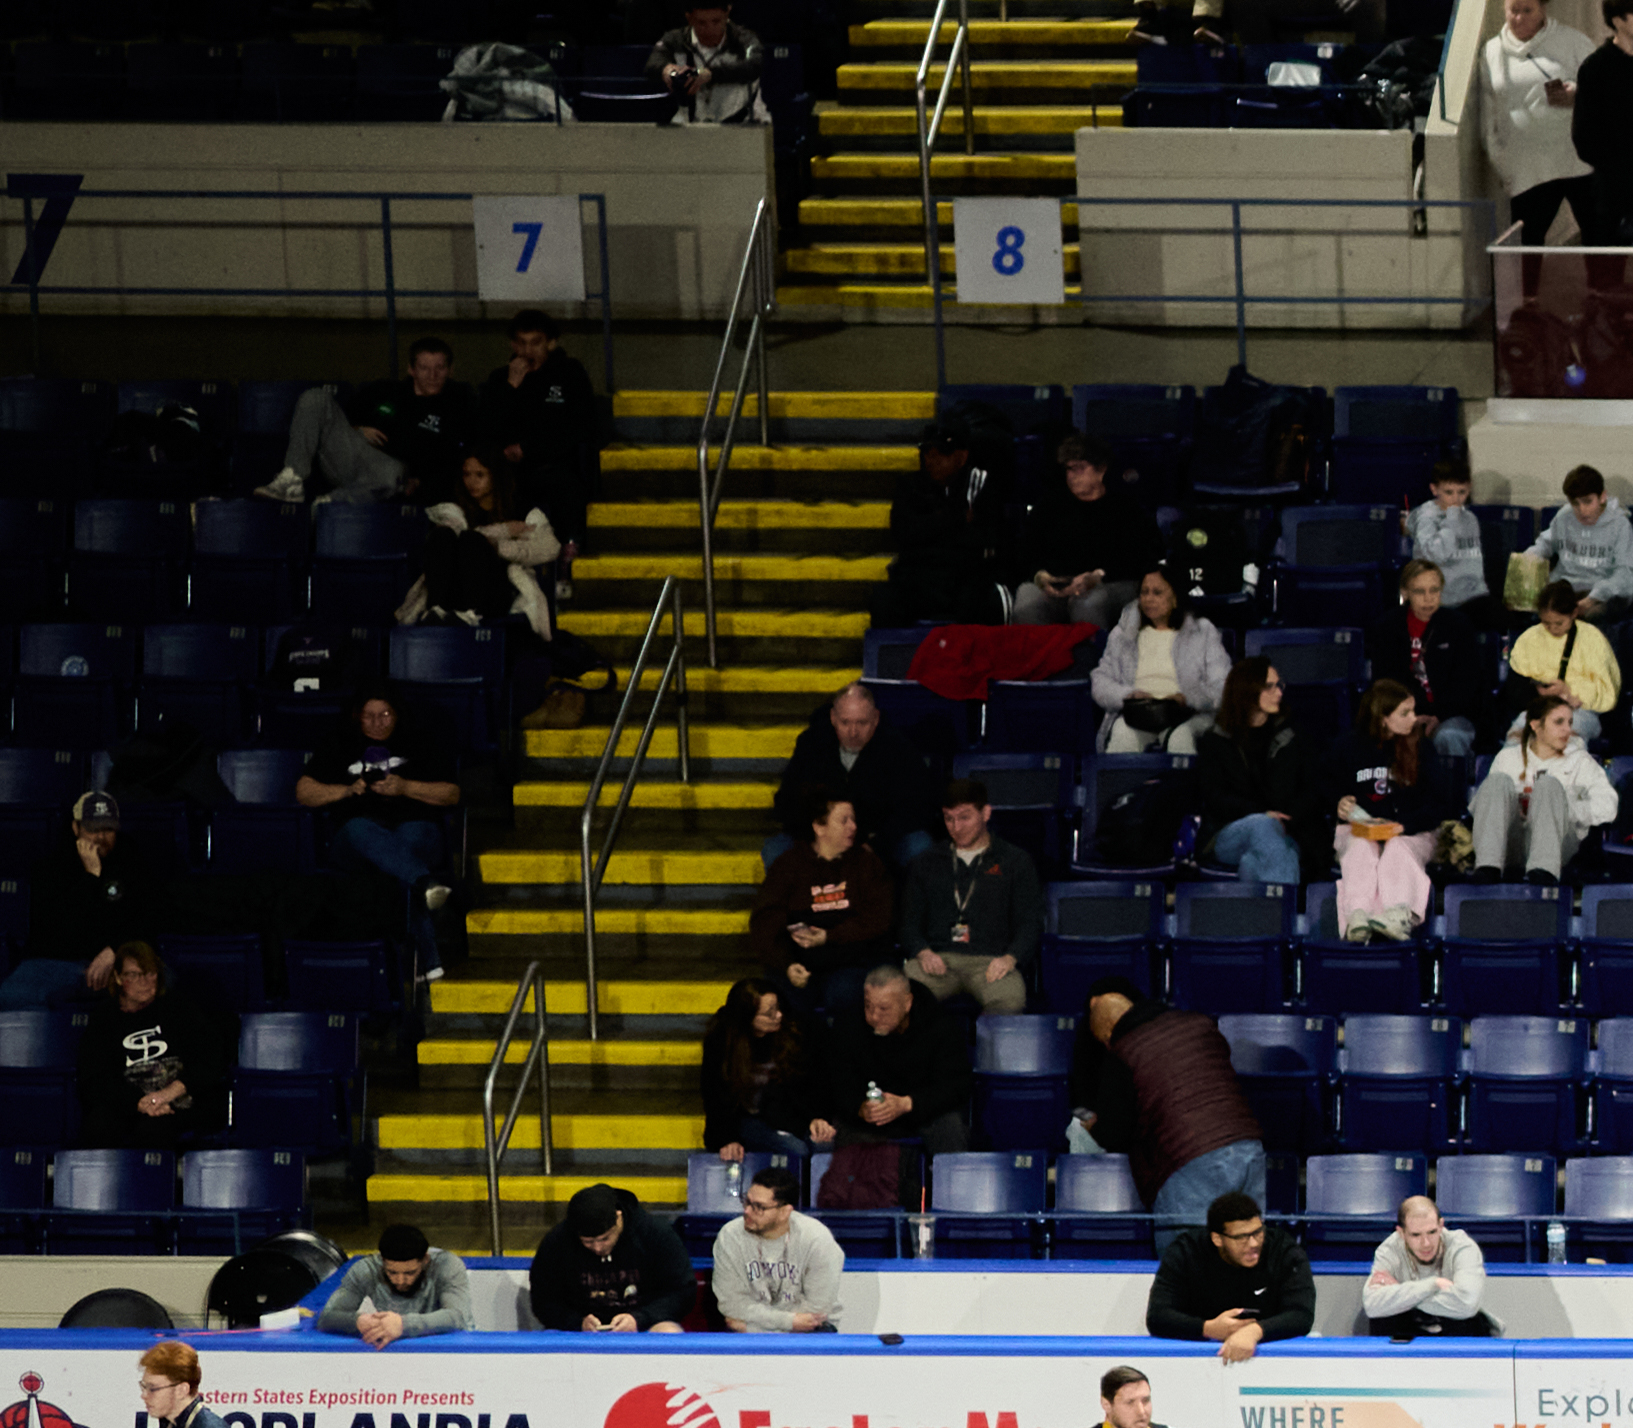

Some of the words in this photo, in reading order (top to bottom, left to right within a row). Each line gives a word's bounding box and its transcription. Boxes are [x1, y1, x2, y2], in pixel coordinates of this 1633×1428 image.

[6, 174, 84, 285] 7
[512, 222, 543, 273] 7
[992, 225, 1023, 276] 8
[199, 1390, 250, 1405] astern
[255, 1389, 303, 1405] States
[309, 1389, 398, 1409] Exposition
[402, 1390, 475, 1405] Presents
